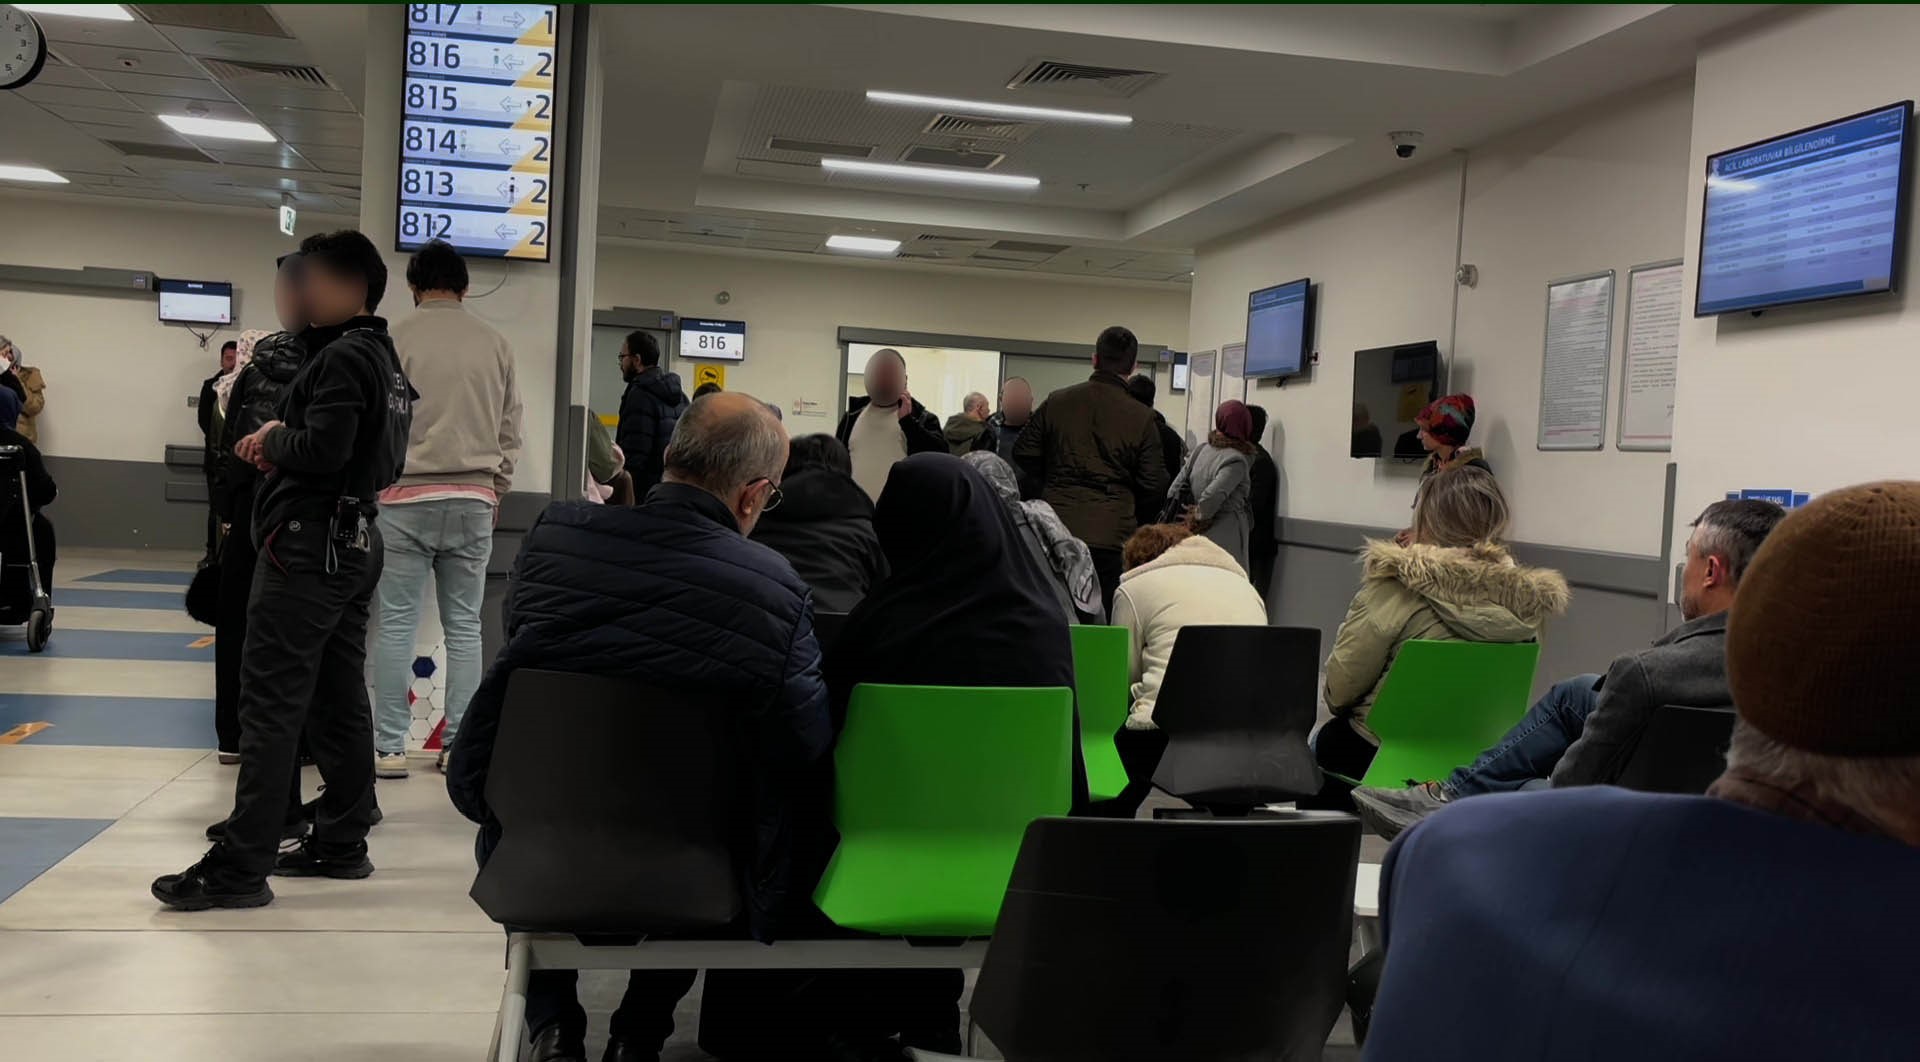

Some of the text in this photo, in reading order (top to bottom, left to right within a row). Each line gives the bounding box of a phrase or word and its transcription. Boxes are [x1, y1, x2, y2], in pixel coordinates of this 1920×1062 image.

[15, 24, 22, 32] 2
[411, 4, 553, 35] 817 1
[16, 53, 23, 61] 4
[21, 39, 27, 47] 3
[409, 41, 552, 77] 816 2
[407, 84, 550, 119] 815 2
[405, 127, 548, 161] 814 2
[1784, 135, 1836, 157] BİLGİLENDİRME
[404, 169, 547, 203] 813 2
[402, 212, 545, 246] 812 2
[699, 335, 726, 350] 816
